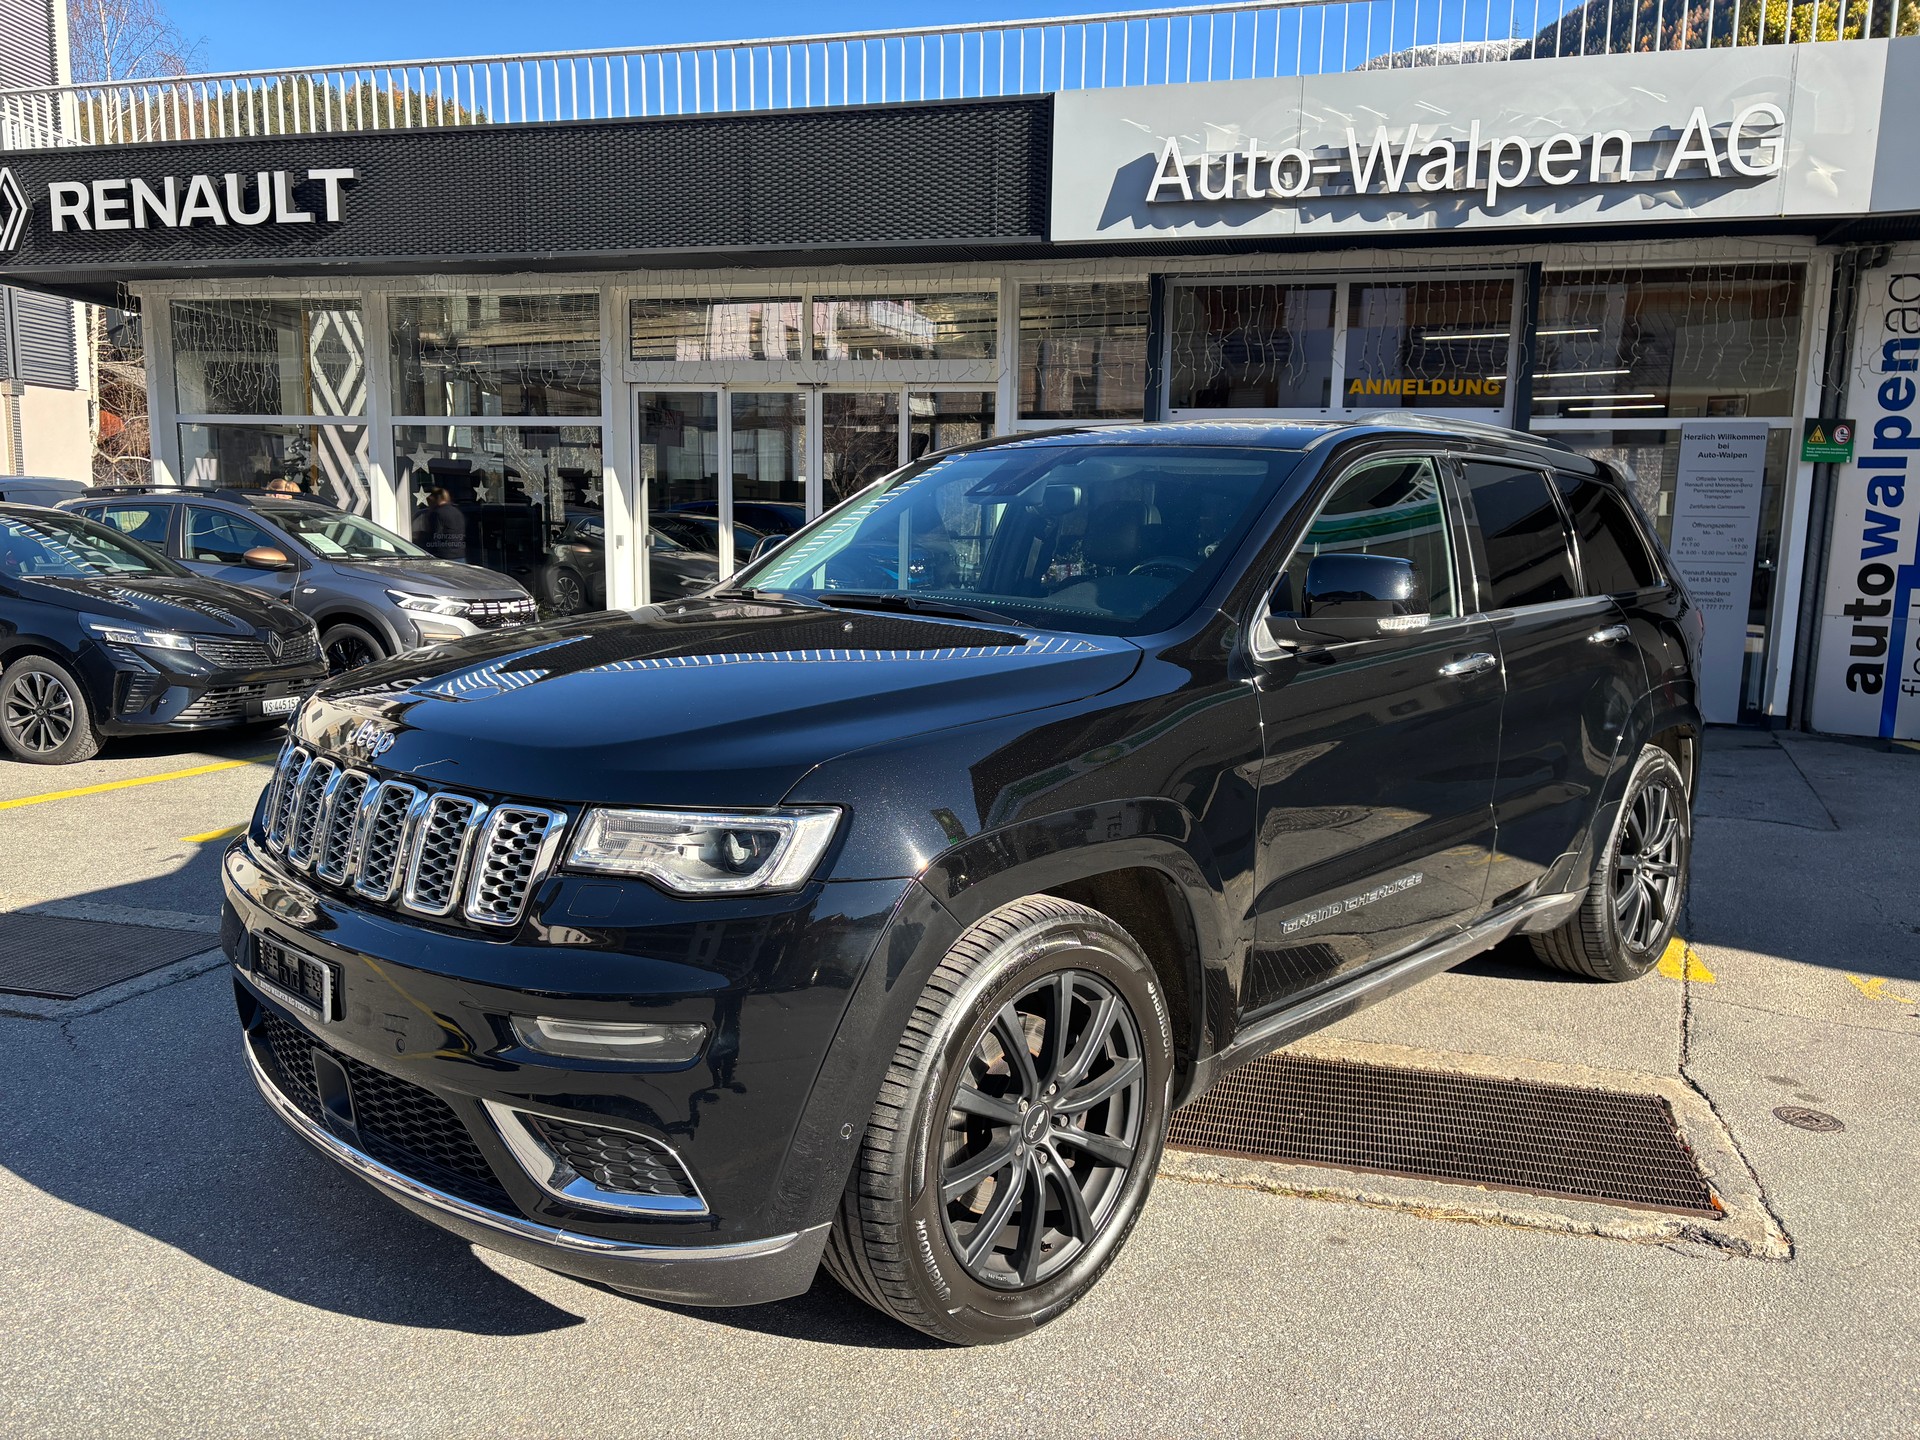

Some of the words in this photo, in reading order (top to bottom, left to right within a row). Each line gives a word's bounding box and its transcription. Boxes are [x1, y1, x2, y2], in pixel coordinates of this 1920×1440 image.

[1146, 119, 1632, 207] Auto-Walpen
[1664, 102, 1786, 179] AG
[49, 168, 355, 232] RENAULT
[1348, 378, 1500, 395] ANMELDUNG
[1718, 442, 1730, 450] bei
[346, 720, 395, 757] Jeep
[1280, 902, 1342, 934] GRAND
[1344, 872, 1424, 912] CHEROKEE
